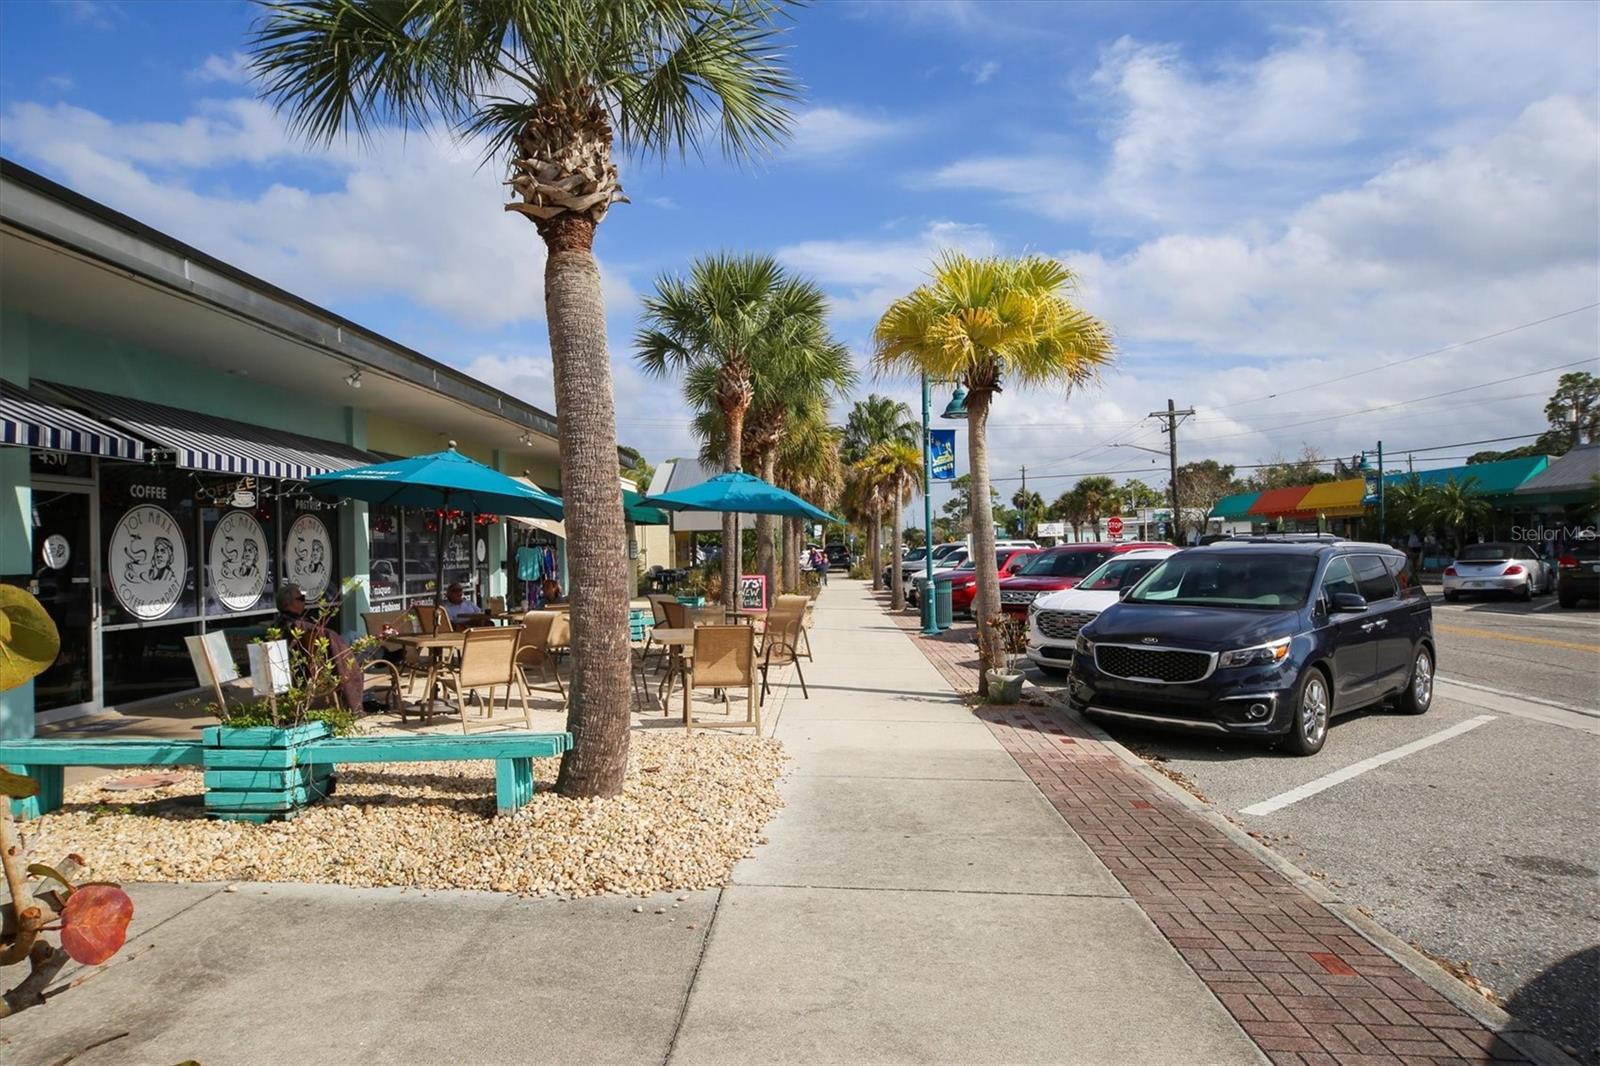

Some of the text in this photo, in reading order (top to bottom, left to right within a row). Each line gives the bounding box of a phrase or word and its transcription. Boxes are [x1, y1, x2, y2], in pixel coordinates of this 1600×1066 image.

[129, 484, 168, 500] COFFEE
[194, 476, 257, 500] COFFEE
[123, 511, 143, 537] JOE
